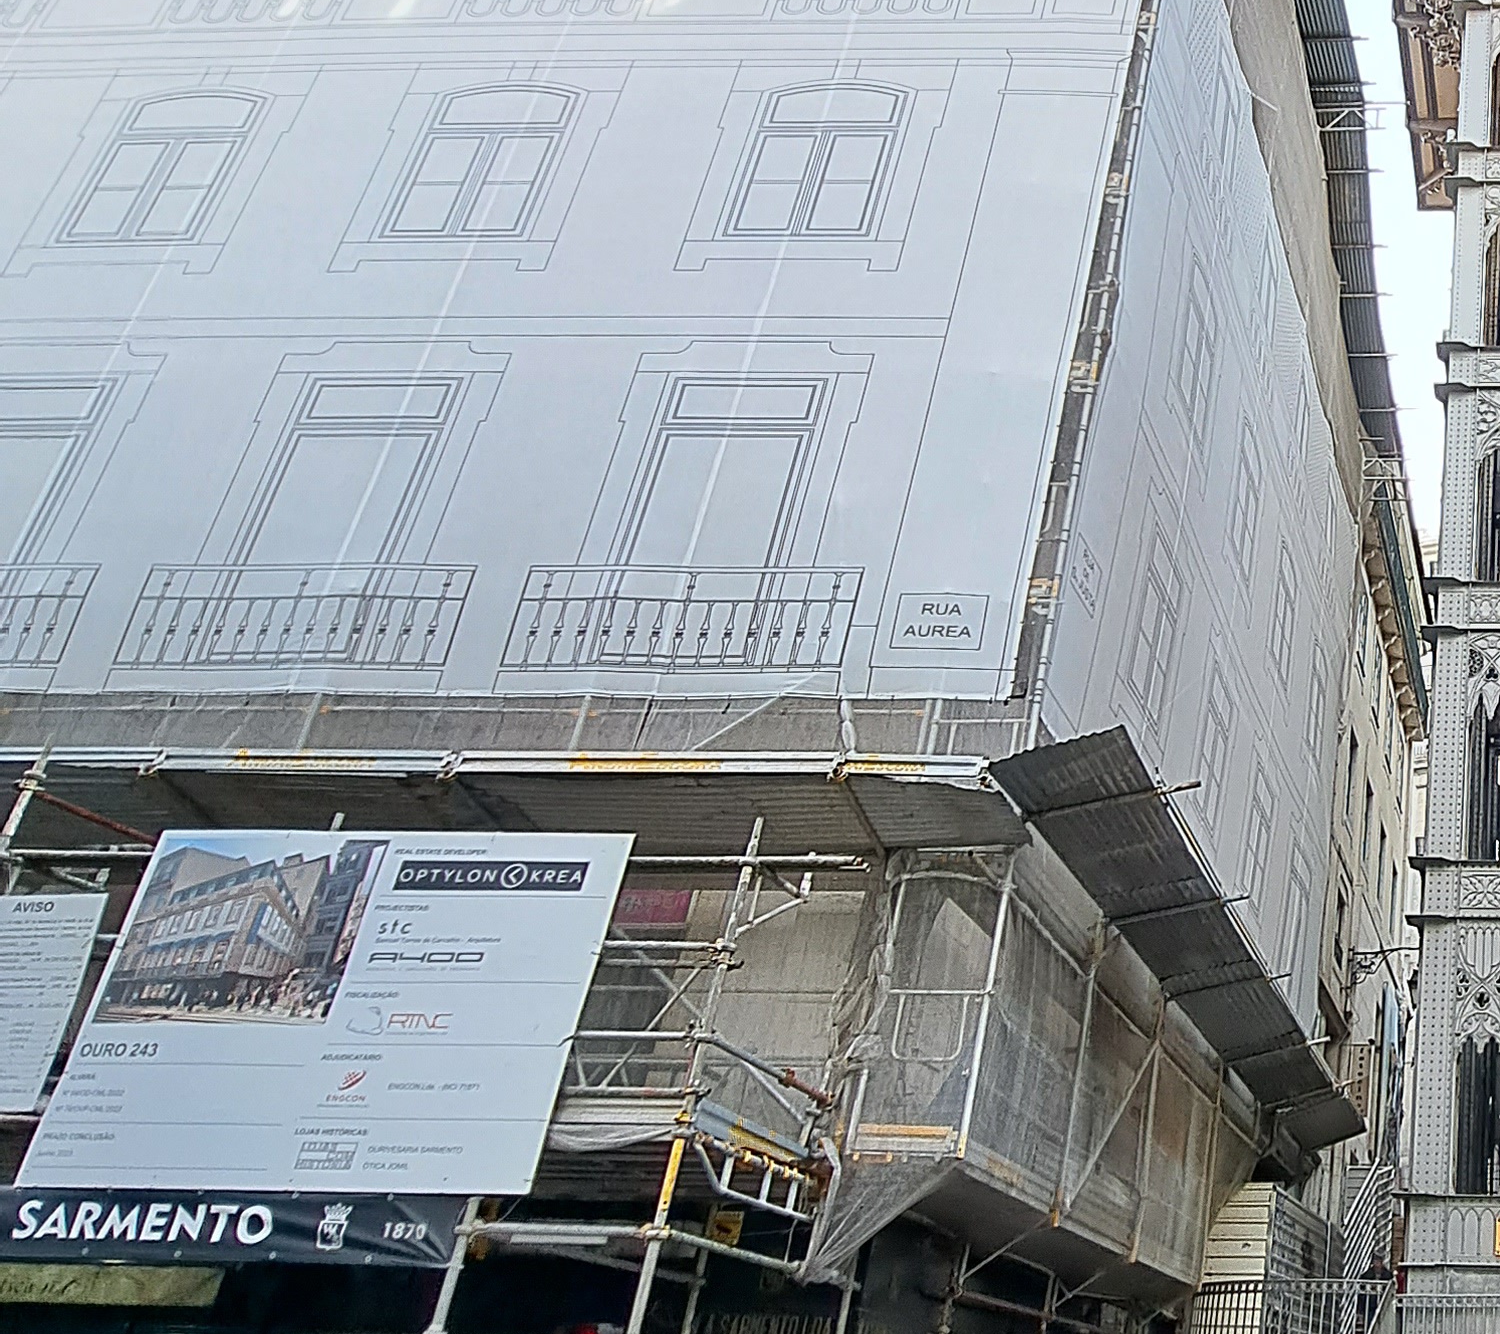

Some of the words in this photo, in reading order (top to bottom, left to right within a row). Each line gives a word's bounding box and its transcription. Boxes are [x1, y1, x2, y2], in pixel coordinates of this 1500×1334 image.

[921, 603, 962, 616] RUA
[903, 625, 972, 638] AUREA
[400, 868, 499, 883] OPTYLON
[529, 869, 583, 884] KREA
[12, 901, 55, 913] AVISO
[378, 919, 413, 935] stc
[368, 952, 485, 964] A400
[80, 1043, 128, 1058] OURO
[128, 1043, 159, 1057] 243
[12, 1199, 273, 1245] SARMENTO
[383, 1222, 428, 1240] 1870
